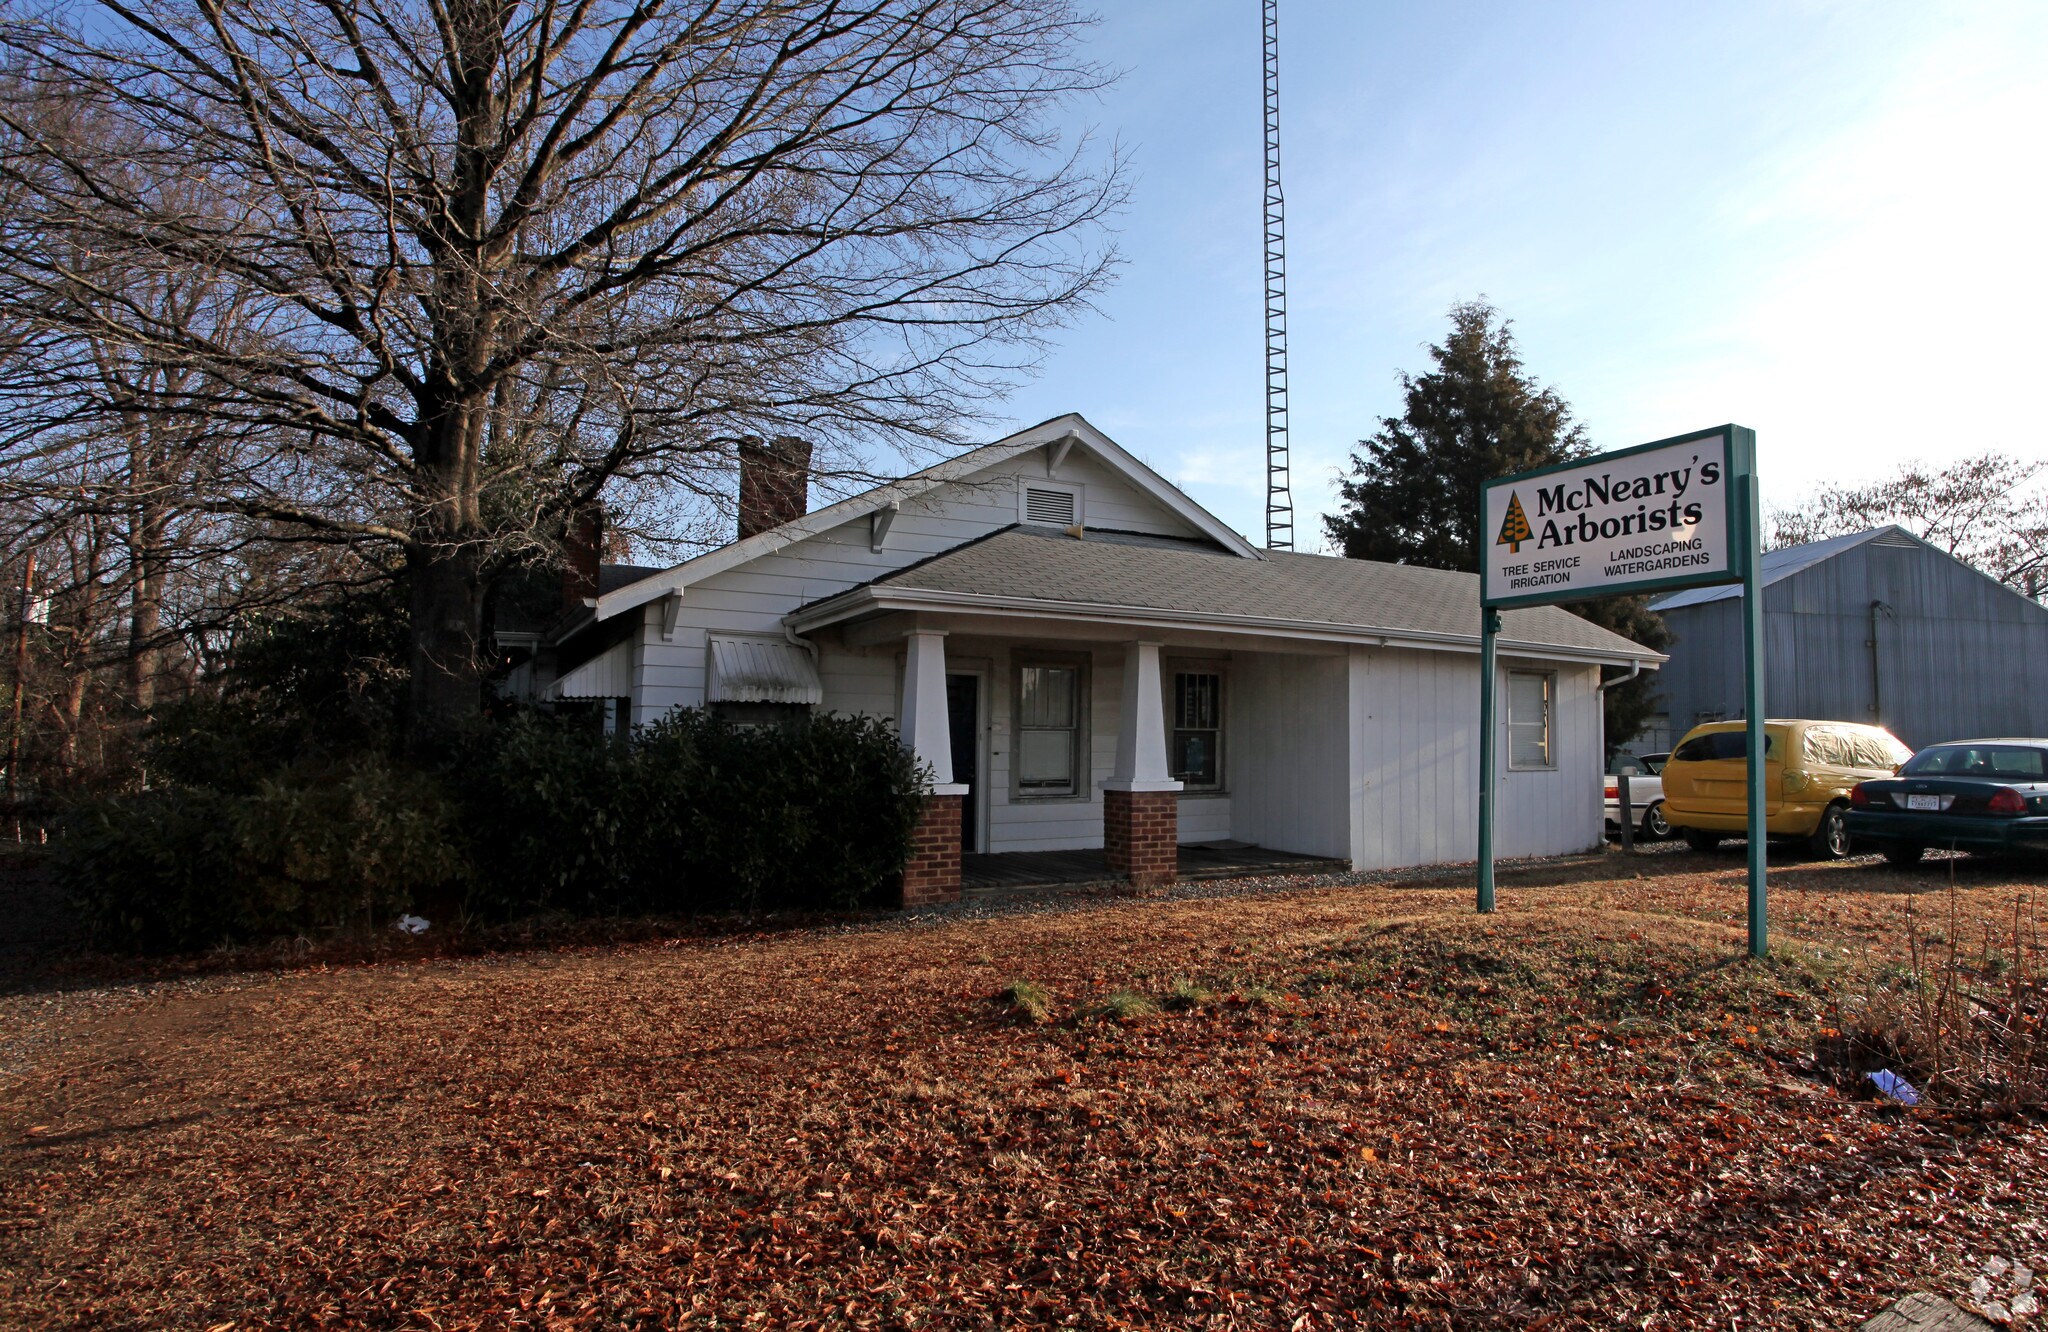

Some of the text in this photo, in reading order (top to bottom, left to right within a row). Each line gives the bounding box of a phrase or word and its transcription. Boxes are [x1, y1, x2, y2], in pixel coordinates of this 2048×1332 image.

[1536, 455, 1719, 517] McNeary's
[1537, 500, 1702, 549] Arborists
[1610, 538, 1702, 562] LANDSCAPING
[1502, 556, 1581, 577] TREE SERVICE
[1604, 552, 1710, 577] WATERGARDENS
[1510, 572, 1570, 589] IRRIGATION
